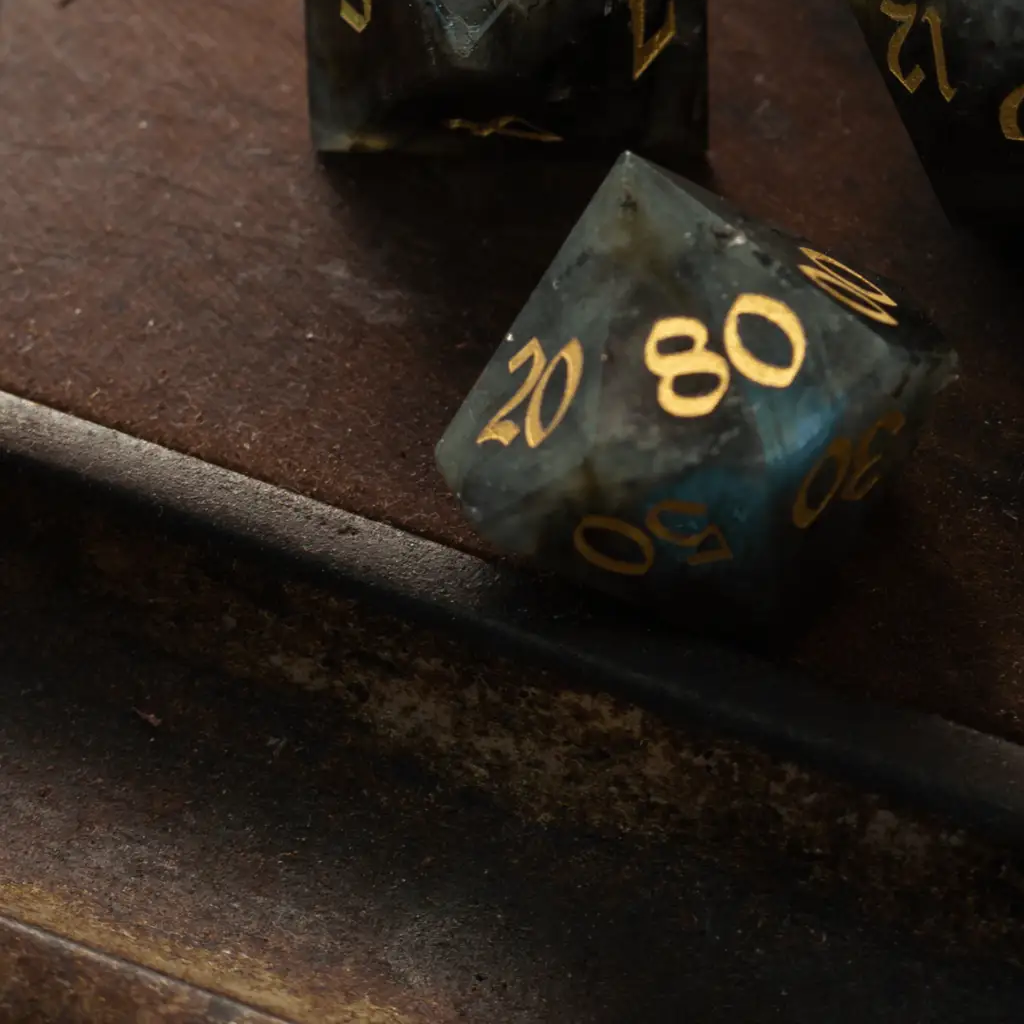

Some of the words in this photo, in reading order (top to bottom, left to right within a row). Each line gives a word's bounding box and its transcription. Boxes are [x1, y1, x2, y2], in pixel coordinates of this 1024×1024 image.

[476, 337, 584, 448] 20
[644, 293, 806, 418] 80
[792, 412, 905, 530] 30
[573, 500, 733, 575] 50
